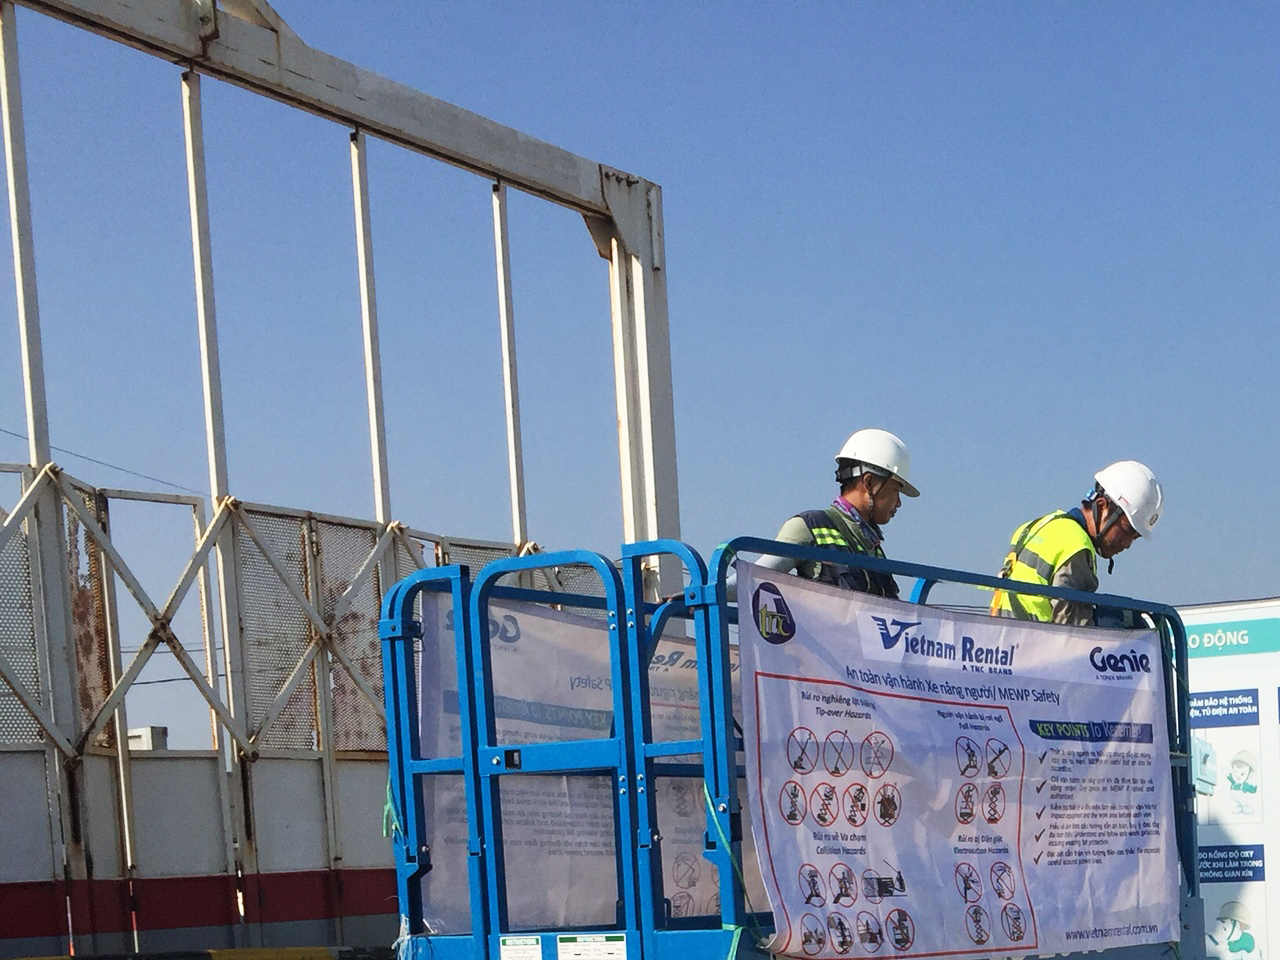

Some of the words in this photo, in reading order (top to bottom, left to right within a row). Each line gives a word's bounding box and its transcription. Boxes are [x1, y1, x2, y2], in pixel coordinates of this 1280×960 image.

[870, 615, 956, 661] Vietnam
[1089, 646, 1151, 673] Genie
[1203, 629, 1249, 651] ĐỘNG
[845, 665, 859, 680] An
[859, 669, 882, 686] toàn
[883, 674, 899, 689] vận
[900, 674, 926, 691] hành
[927, 680, 939, 694] Xe
[940, 680, 964, 700] nâng
[998, 687, 1030, 702] MEWP
[1032, 689, 1060, 706] Safety
[1037, 723, 1054, 737] KEY
[1056, 723, 1089, 738] POINTS
[842, 846, 866, 855] Hazards
